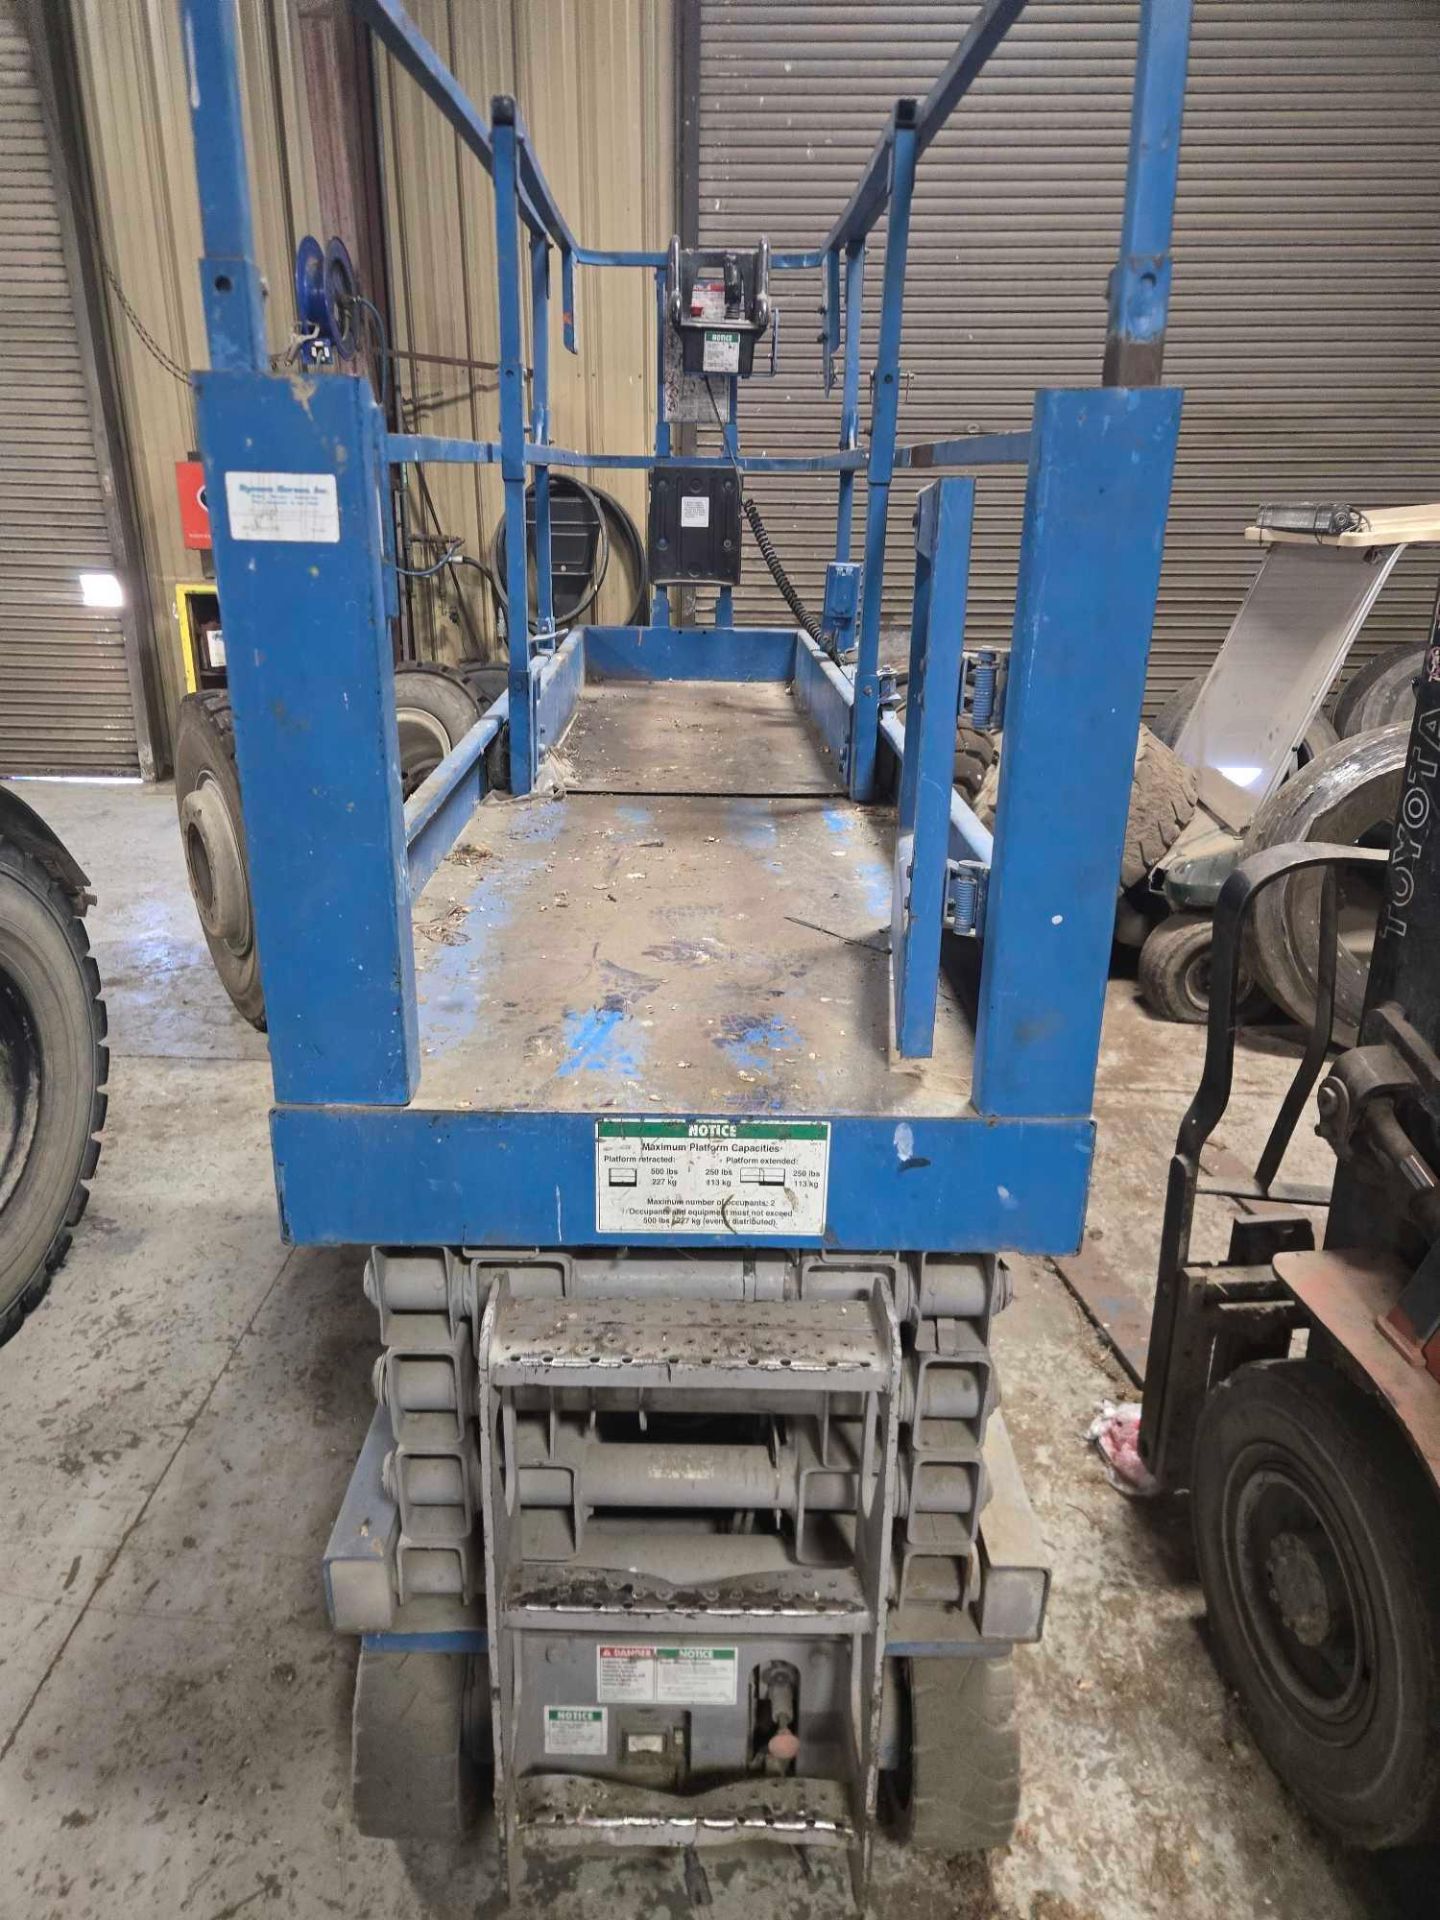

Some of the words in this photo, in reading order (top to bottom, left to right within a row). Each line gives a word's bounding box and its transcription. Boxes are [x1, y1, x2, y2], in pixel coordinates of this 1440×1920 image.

[1382, 708, 1440, 939] TOYOTA
[688, 1125, 737, 1138] NOTICE
[642, 1143, 686, 1152] Maximum
[689, 1143, 729, 1154] Platform
[604, 1155, 637, 1163] Platform
[726, 1157, 759, 1165] Platform
[705, 1168, 719, 1176] 250
[721, 1168, 733, 1176] lbs
[652, 1178, 666, 1186] 227
[667, 1178, 677, 1187] kg
[808, 1180, 819, 1189] kg
[687, 1208, 728, 1217] equipmet
[691, 1218, 701, 1226] kg
[614, 1647, 651, 1657] DANGER
[679, 1648, 714, 1659] NOTICE
[557, 1711, 593, 1721] NOTICE
